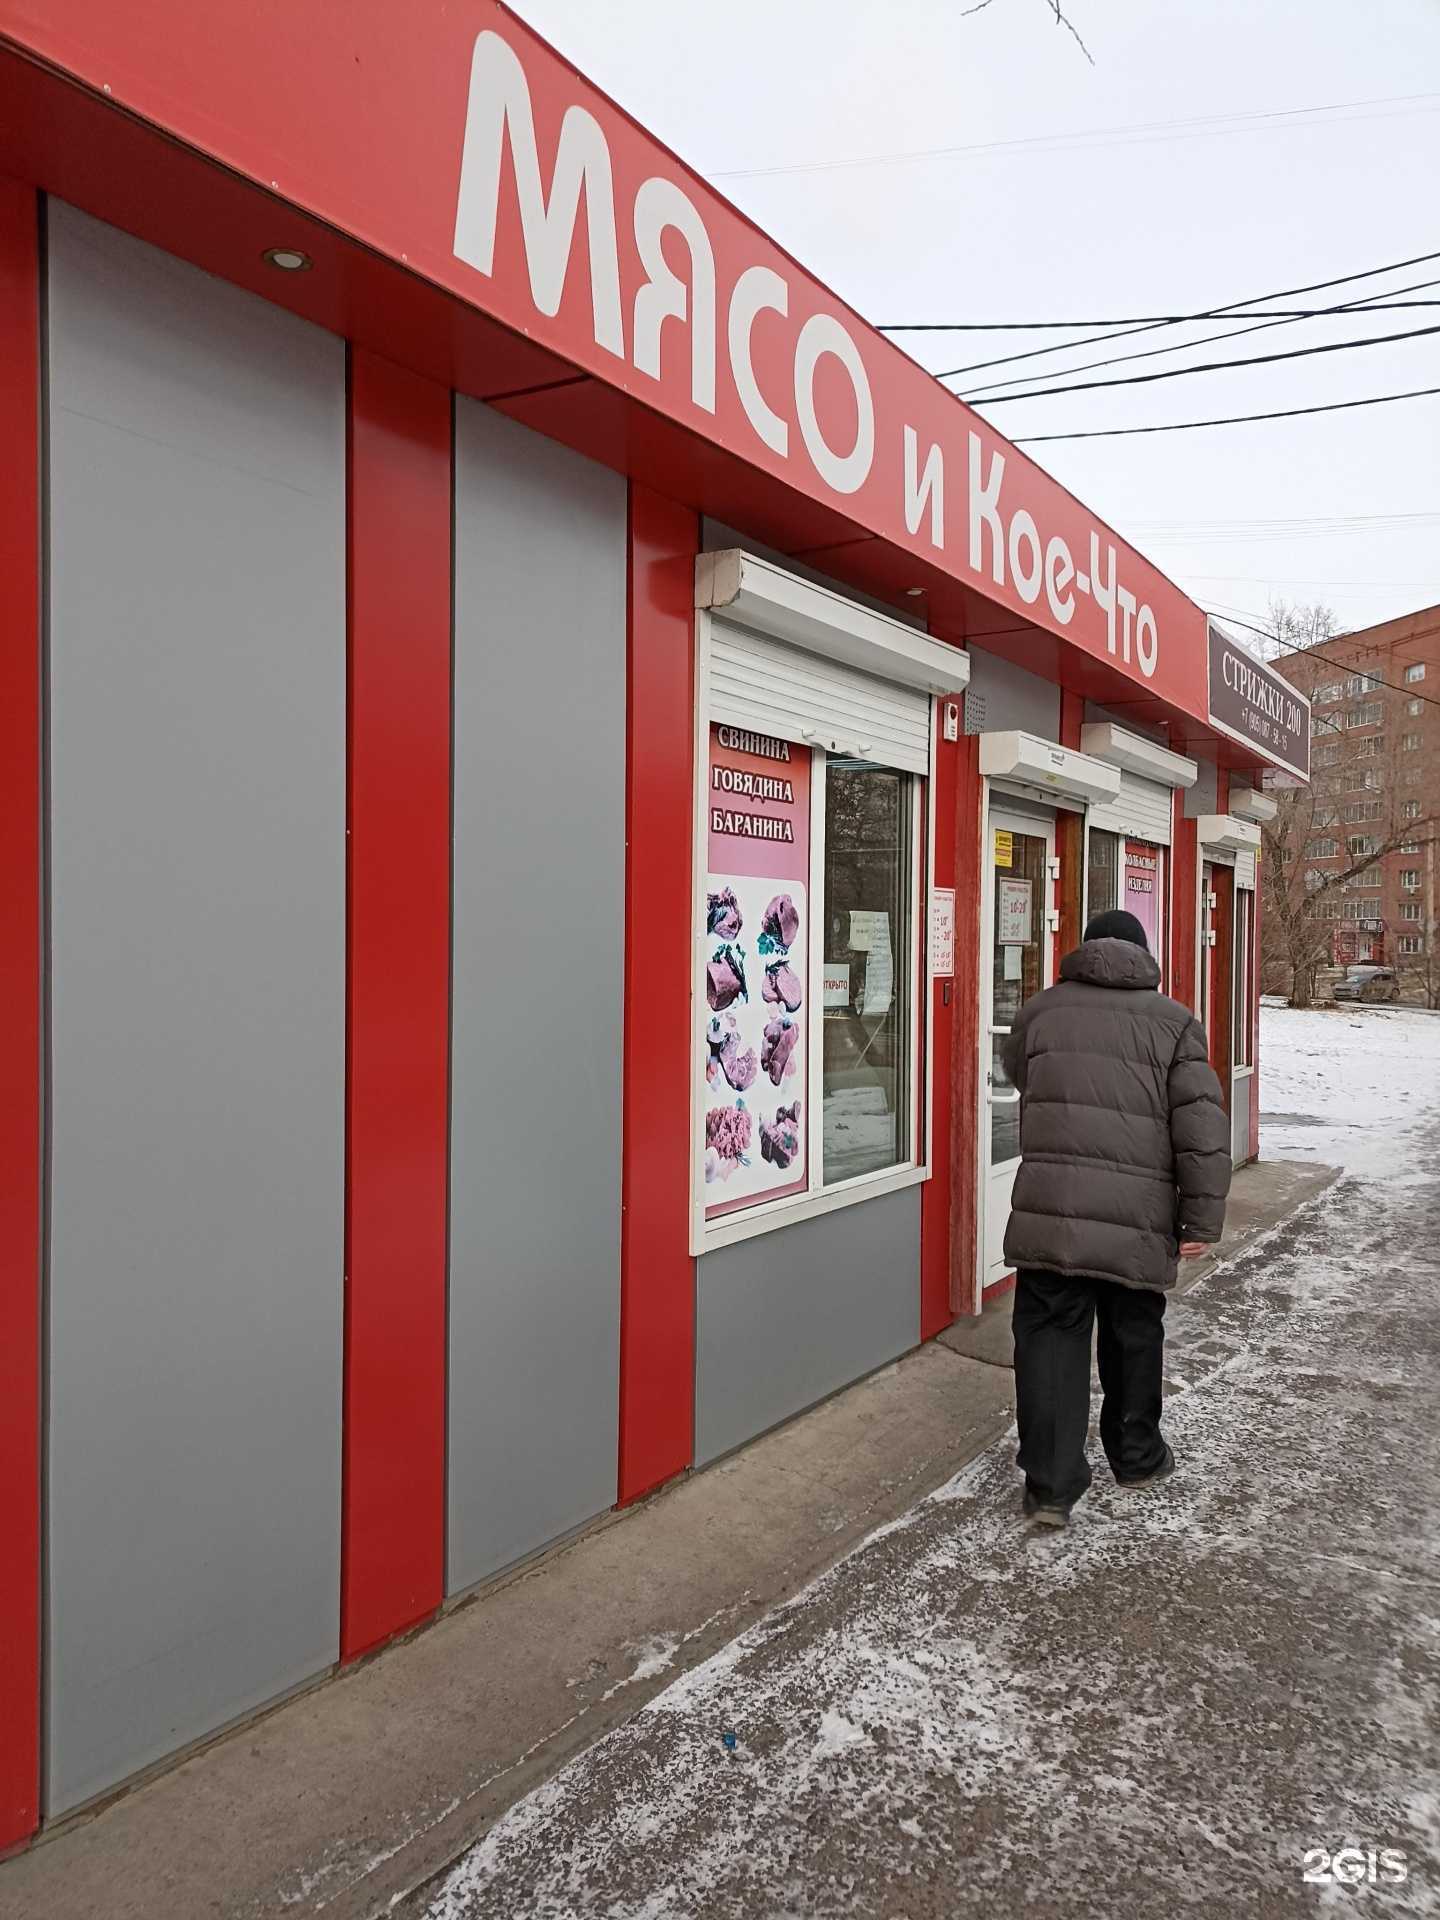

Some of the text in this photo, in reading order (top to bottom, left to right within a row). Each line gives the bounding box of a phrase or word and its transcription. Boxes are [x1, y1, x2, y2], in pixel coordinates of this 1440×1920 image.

[1222, 650, 1301, 737] СТРИЖКИ 200
[718, 725, 791, 762] СВИНИНА
[713, 765, 794, 803] ГОВЯДИНА
[712, 808, 794, 843] БАРАНИНА
